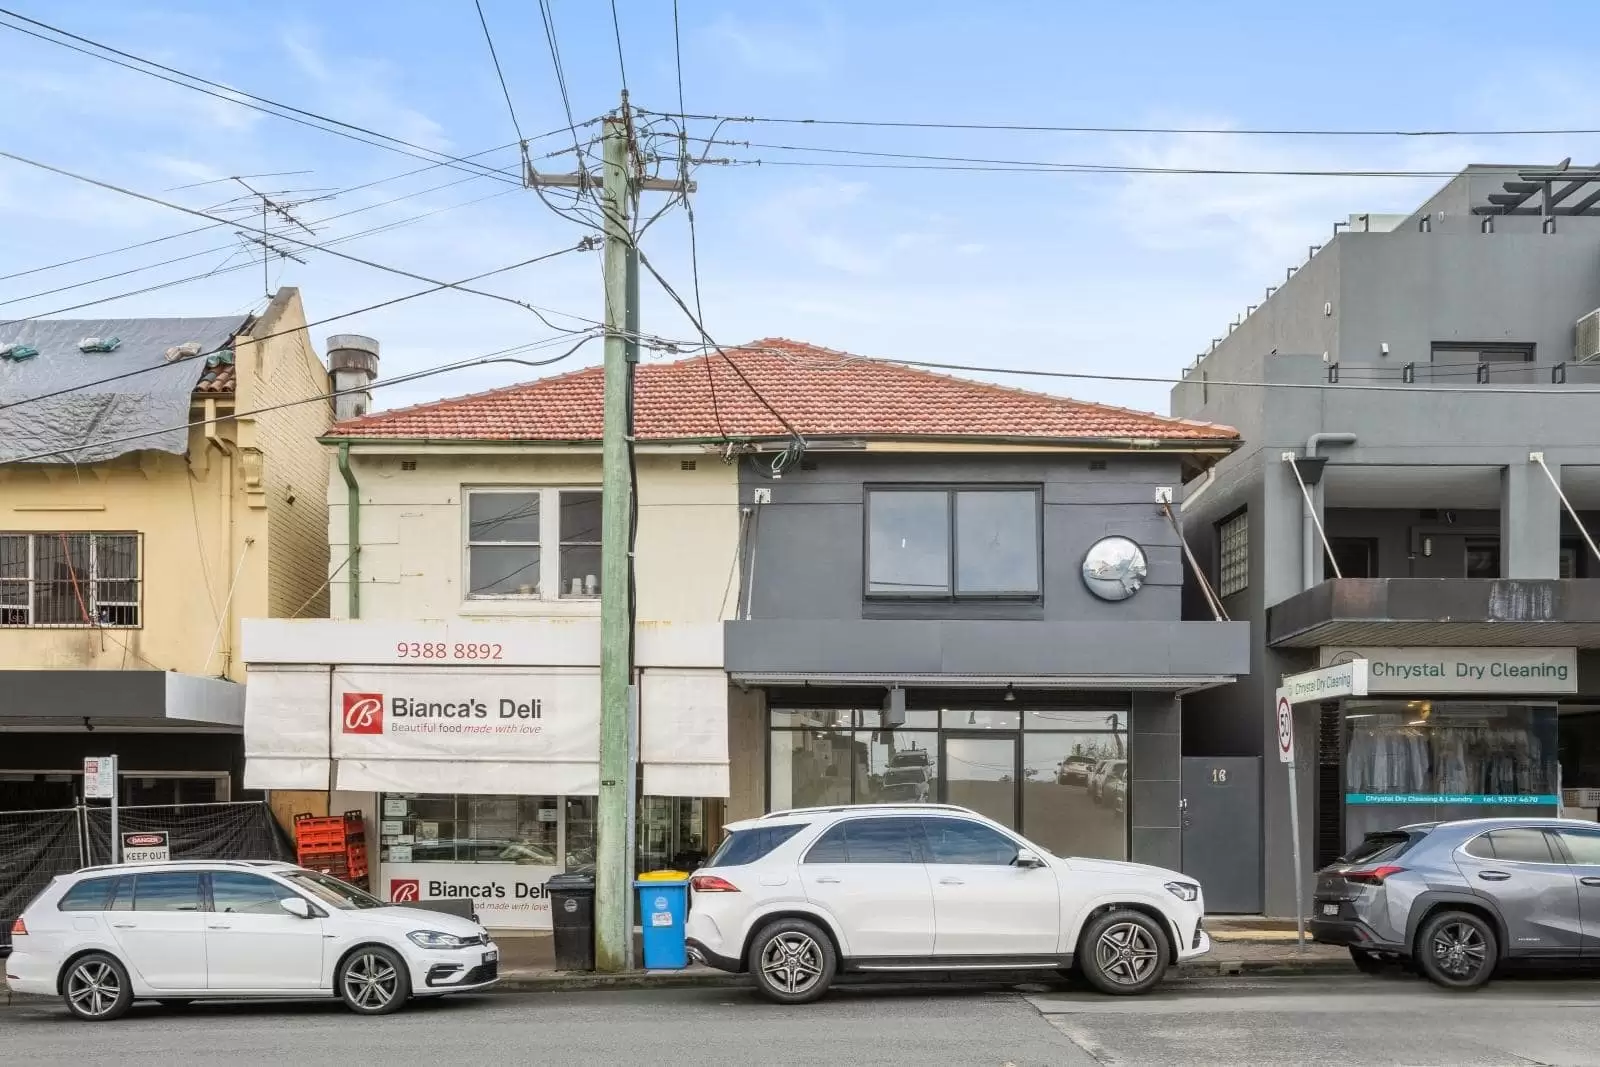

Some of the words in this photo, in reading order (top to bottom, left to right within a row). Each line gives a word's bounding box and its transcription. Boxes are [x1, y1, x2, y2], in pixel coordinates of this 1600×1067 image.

[397, 642, 447, 659] 9388
[453, 643, 503, 660] 8892
[1372, 662, 1446, 679] Chrystal
[1456, 662, 1485, 680] Dry
[1490, 662, 1569, 681] Cleaning
[1327, 673, 1351, 690] Cleaning
[392, 697, 488, 718] Bianca's
[500, 699, 542, 719] Deli
[391, 722, 436, 733] Beautiful
[439, 722, 462, 733] food
[464, 723, 493, 734] made
[495, 723, 517, 734] with
[520, 724, 542, 734] love
[1280, 713, 1289, 738] 50
[1365, 795, 1394, 803] Chrystal
[1395, 795, 1407, 803] Dry
[1408, 795, 1438, 803] Cleaning
[127, 852, 148, 861] KEEP
[149, 851, 167, 860] OUT
[429, 881, 506, 898] Bianca's
[486, 902, 510, 911] made
[511, 902, 530, 911] with
[531, 902, 549, 911] love
